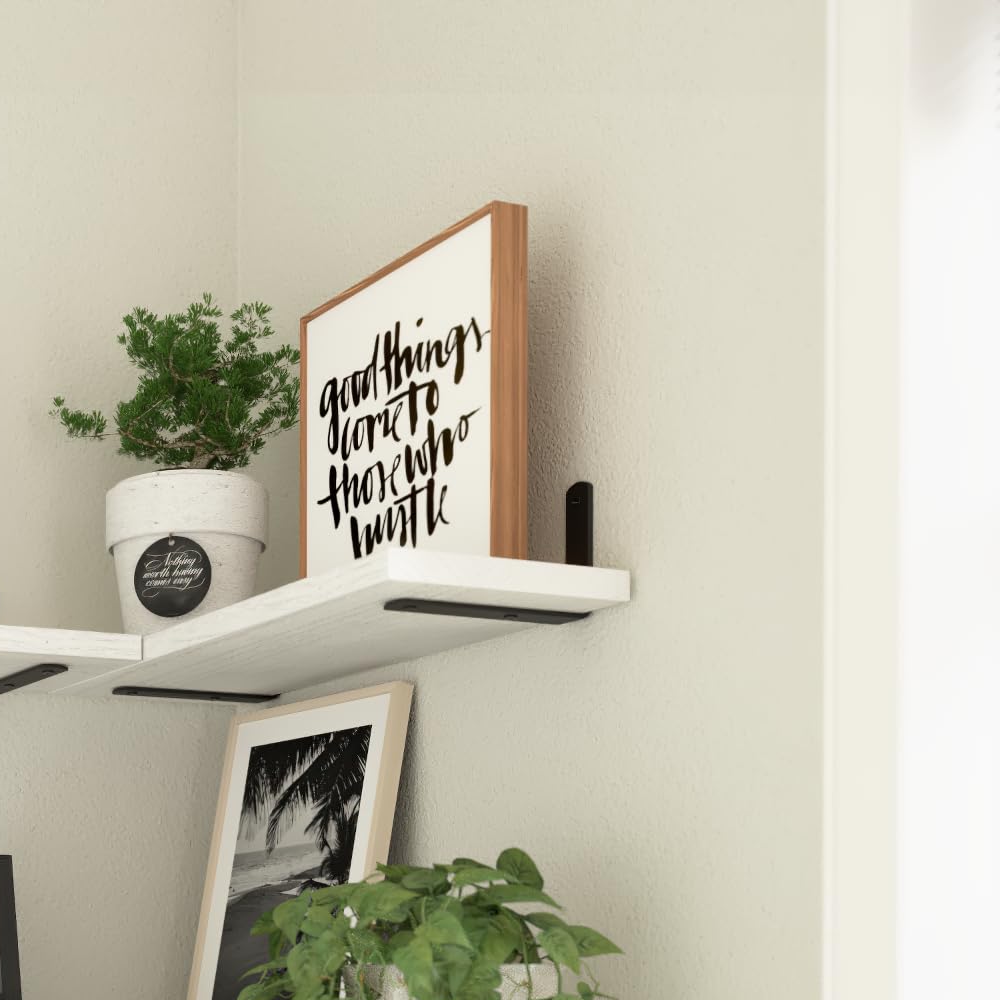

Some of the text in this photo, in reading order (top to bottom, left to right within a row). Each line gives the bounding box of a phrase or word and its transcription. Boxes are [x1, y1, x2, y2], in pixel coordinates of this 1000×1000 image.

[320, 318, 490, 455] good things
[341, 379, 439, 461] come to
[317, 407, 481, 529] those who
[350, 478, 450, 559] hustle
